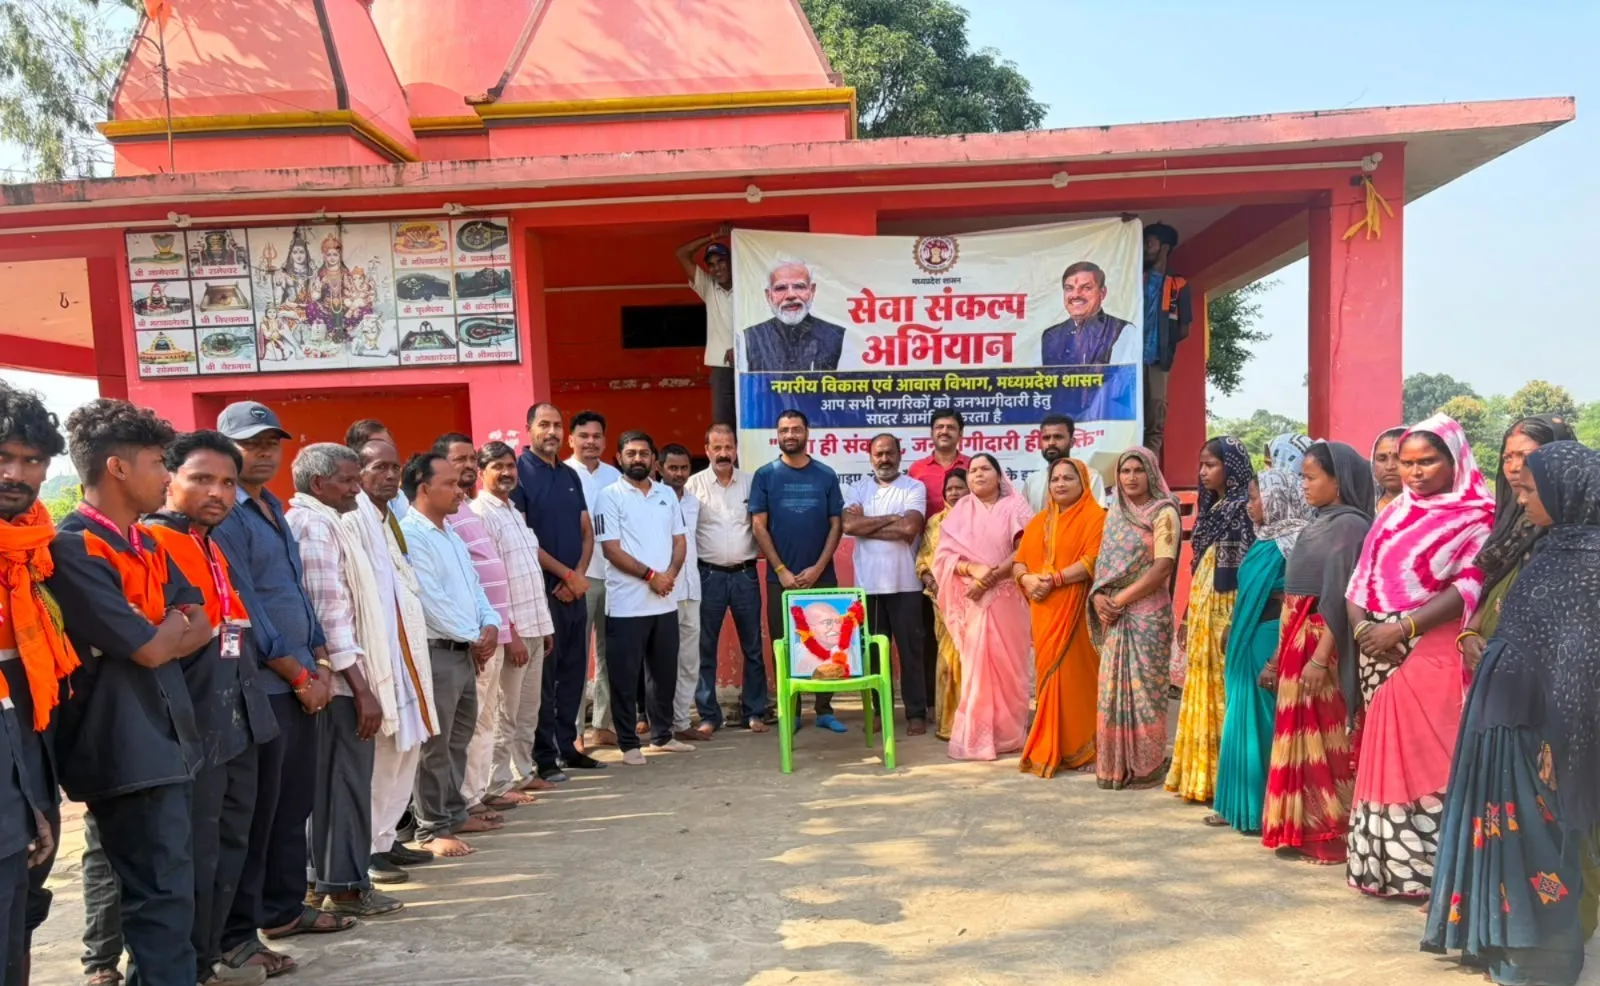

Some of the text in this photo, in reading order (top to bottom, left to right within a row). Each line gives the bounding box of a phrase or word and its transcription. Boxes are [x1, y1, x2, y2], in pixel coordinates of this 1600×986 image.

[912, 276, 962, 285] मध्यप्रदेश शासन
[847, 287, 1027, 324] सेवा संकल्प
[862, 324, 1017, 366] अभियान
[771, 371, 1104, 394] नगरीय विकास एवं आवास विभाग, मध्यप्रदेश शासन
[821, 391, 1053, 411] आप सभी नागरिकों को जनभागीदारी हेतु
[865, 413, 899, 425] सादर
[993, 408, 1003, 424] है
[819, 433, 839, 456] ही
[1024, 429, 1043, 453] ही
